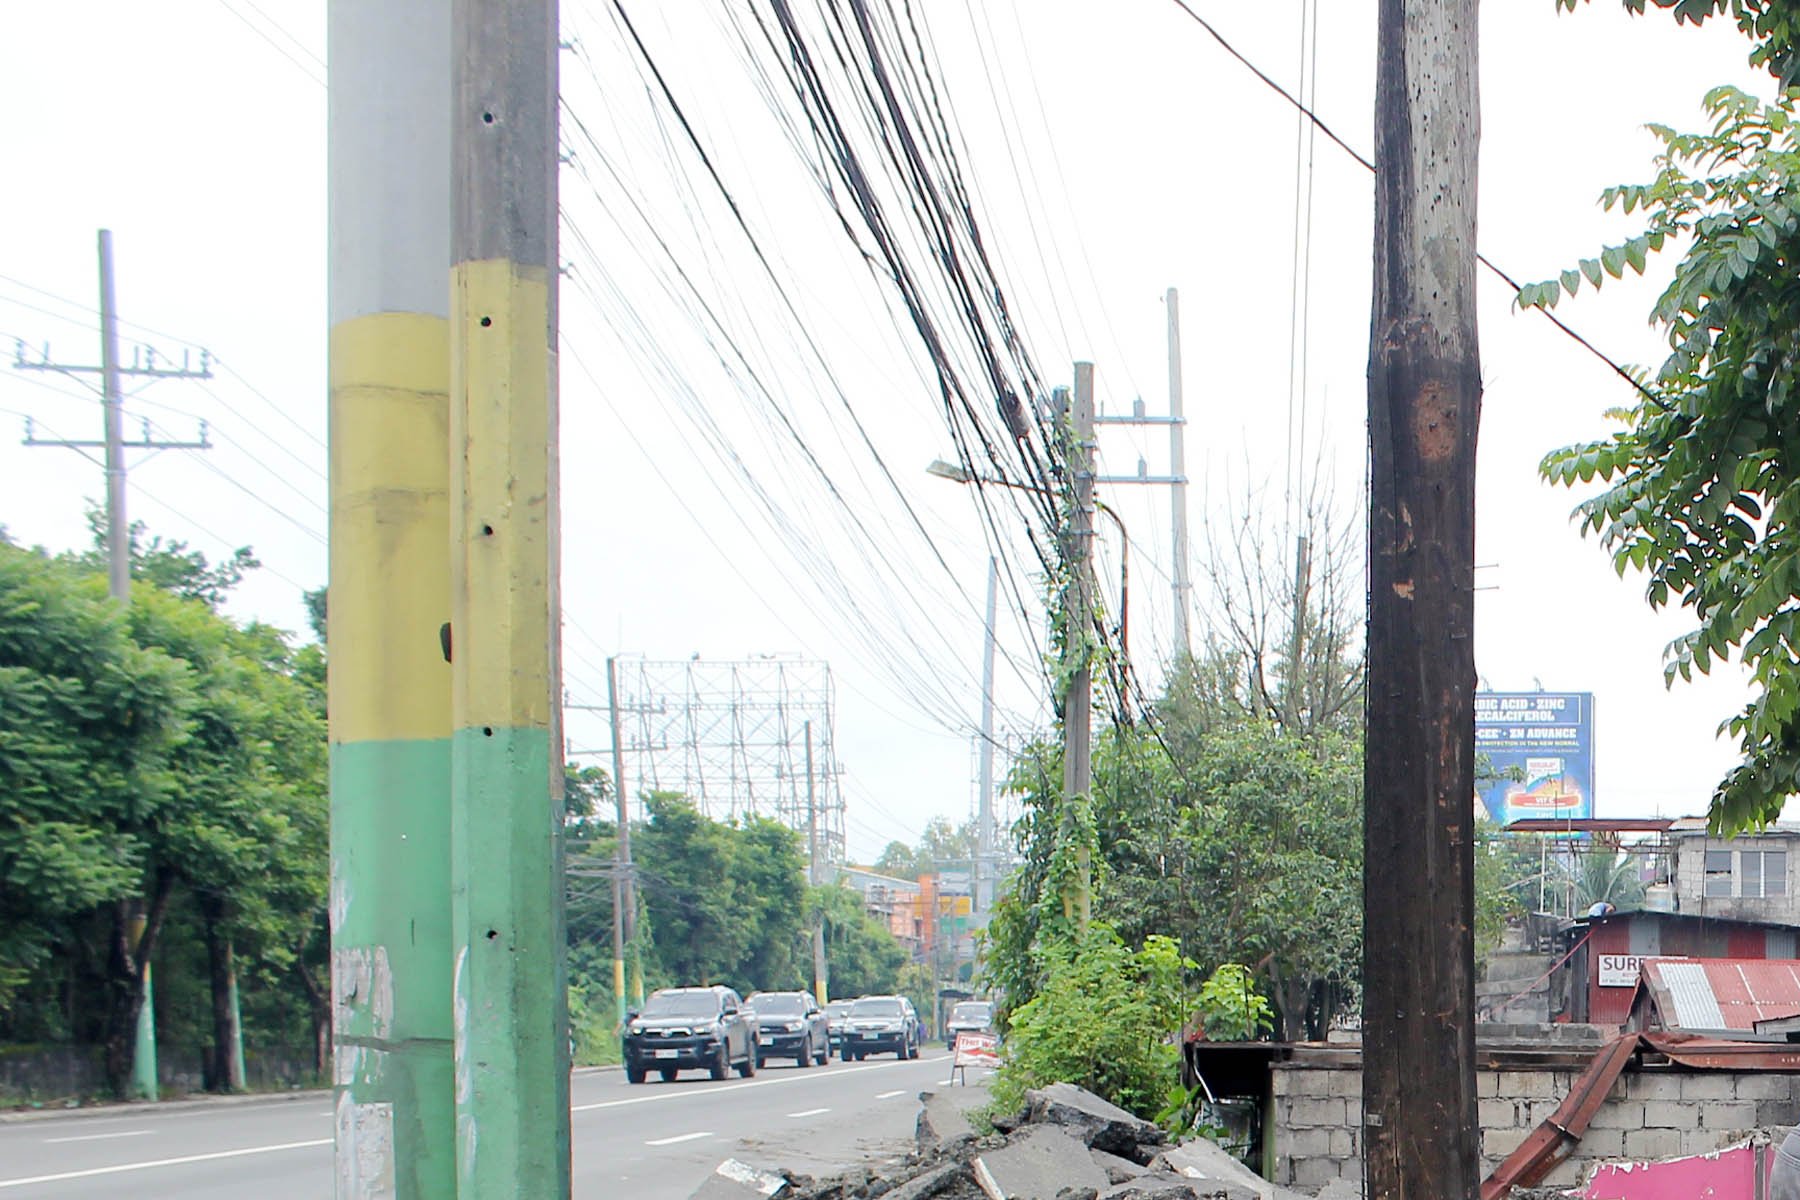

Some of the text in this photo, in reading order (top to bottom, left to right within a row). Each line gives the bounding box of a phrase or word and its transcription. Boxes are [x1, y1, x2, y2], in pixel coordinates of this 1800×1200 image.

[1500, 698, 1528, 710] ACID
[1536, 698, 1565, 710] ZINC
[1509, 728, 1525, 739] ZN
[1526, 728, 1577, 739] ADVANCE
